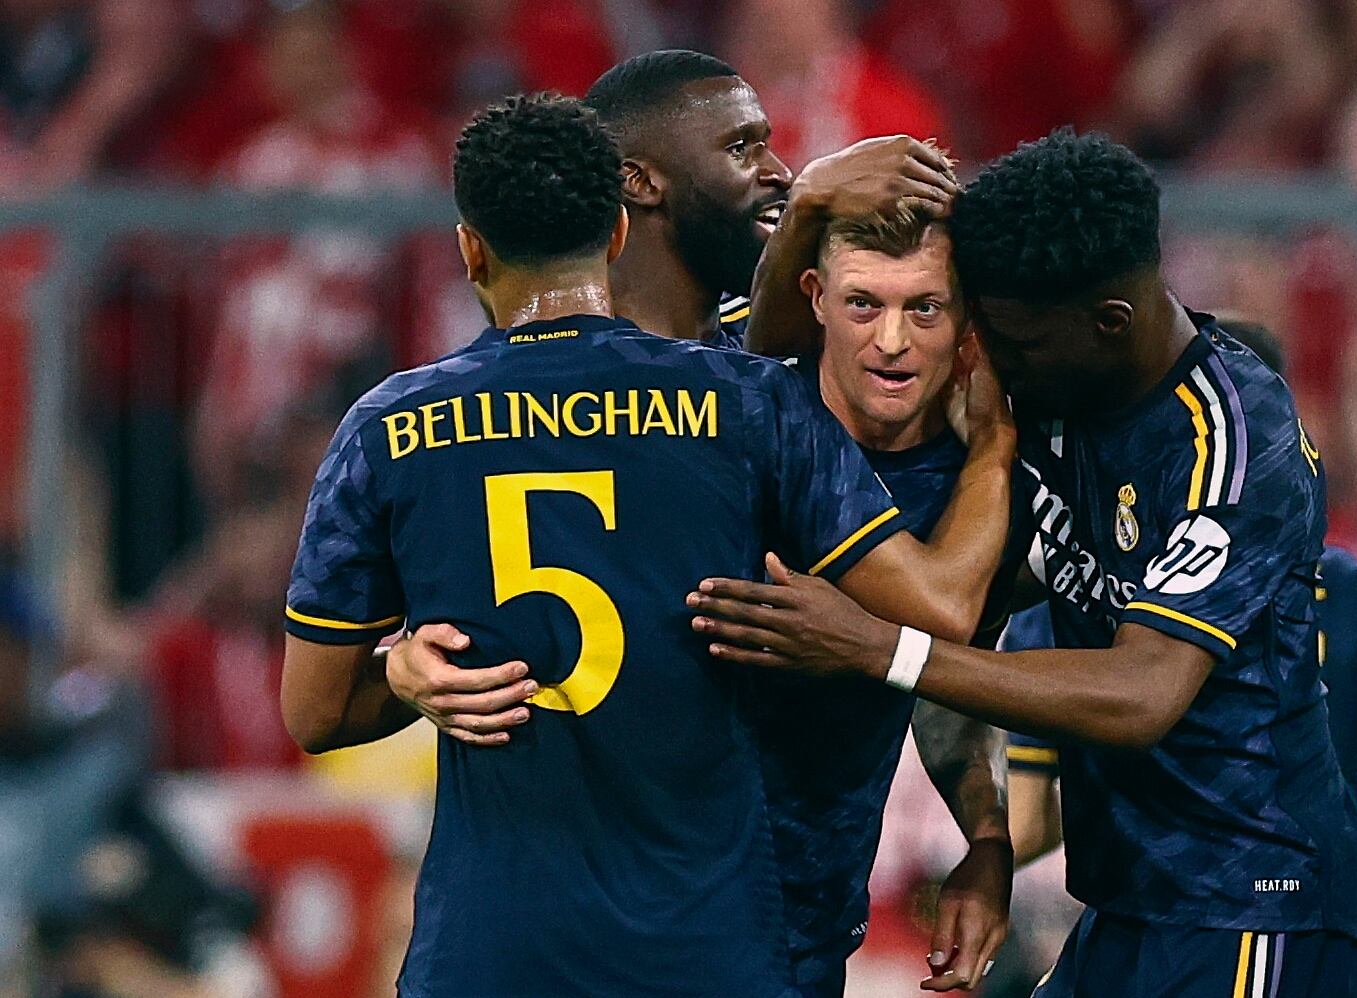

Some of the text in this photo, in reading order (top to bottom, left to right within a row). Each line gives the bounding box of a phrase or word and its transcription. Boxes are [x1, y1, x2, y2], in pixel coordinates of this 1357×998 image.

[510, 330, 580, 345] REAL MADRID
[381, 389, 718, 460] BELLINGHAM
[484, 469, 625, 716] 5
